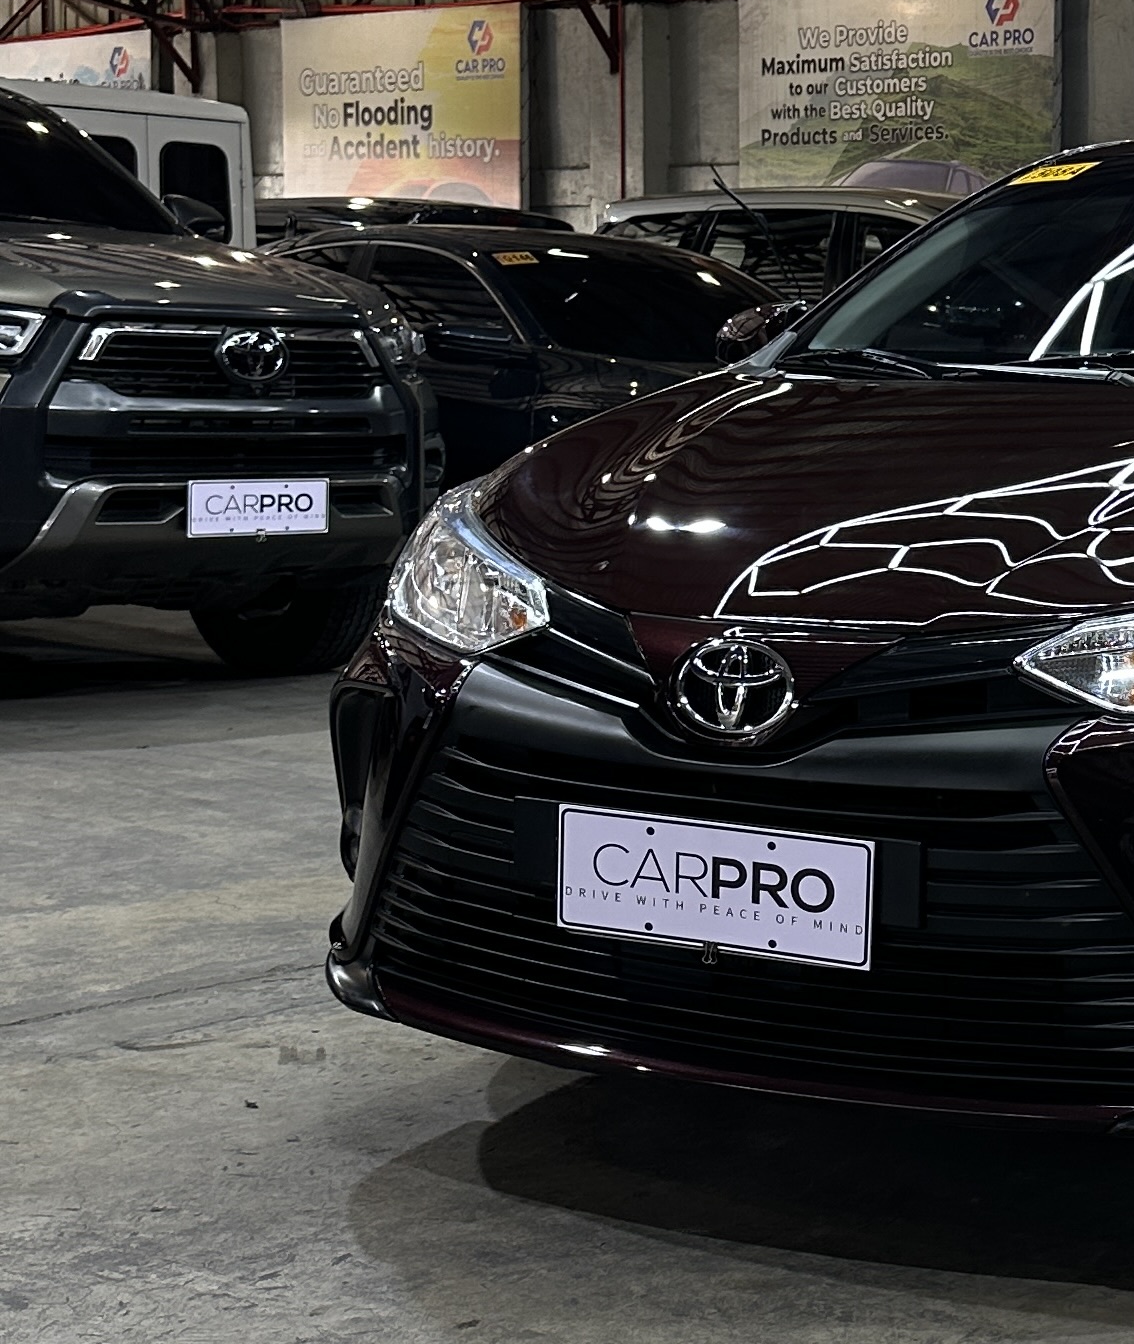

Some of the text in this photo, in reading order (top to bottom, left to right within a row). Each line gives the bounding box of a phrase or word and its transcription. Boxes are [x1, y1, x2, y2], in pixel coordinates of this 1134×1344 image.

[799, 19, 908, 49] We Provide
[969, 27, 1034, 48] CAR PRO
[455, 58, 506, 74] CAR PRO
[761, 47, 953, 76] Maximum Satisfaction
[300, 61, 425, 96] Guaranteed
[789, 75, 927, 97] to our Customers
[313, 97, 433, 131] No Flooding
[770, 96, 934, 122] with the Best Quality
[303, 131, 500, 164] and Accident history.
[760, 121, 949, 148] Products and Services.
[205, 493, 313, 515] CARPRO
[593, 843, 835, 913] CARPRO
[565, 886, 863, 936] DRIVE WITH PEACE OF MIND
